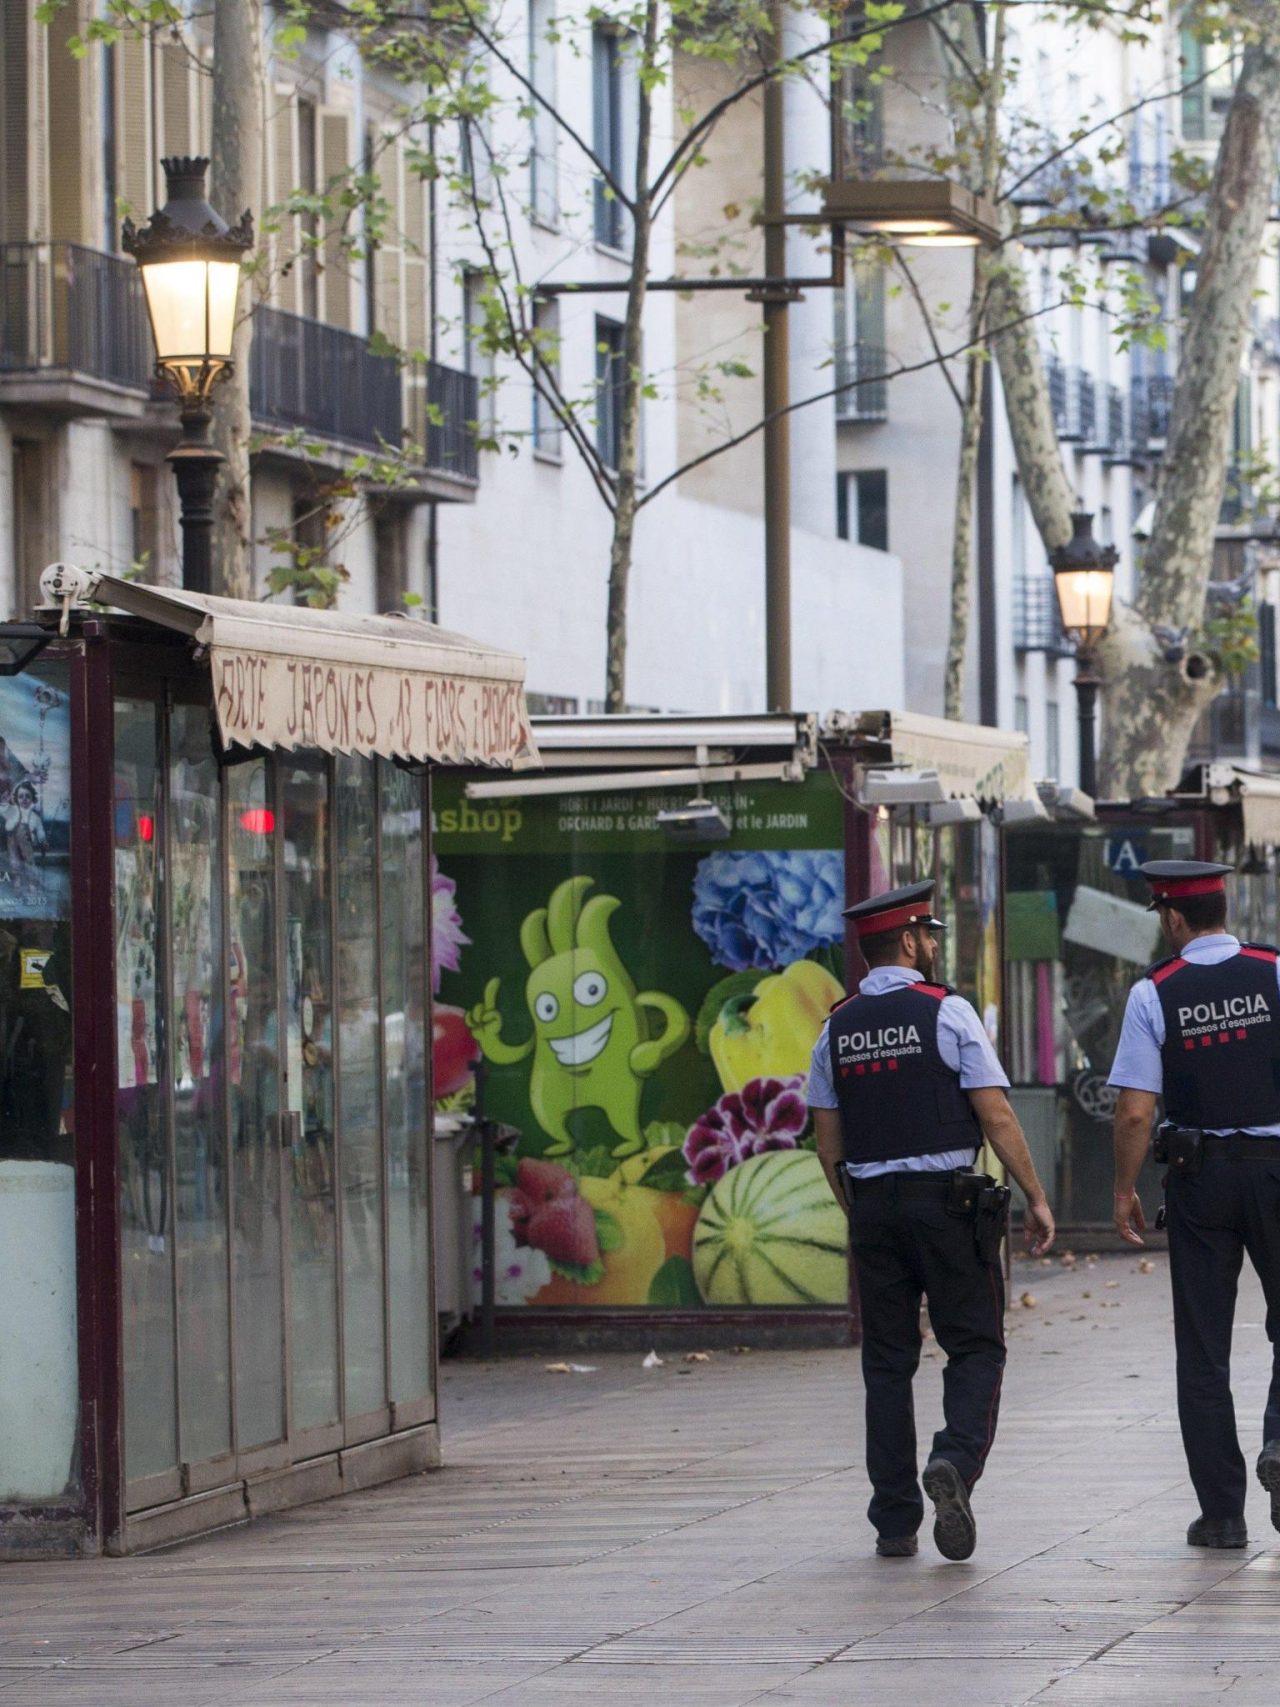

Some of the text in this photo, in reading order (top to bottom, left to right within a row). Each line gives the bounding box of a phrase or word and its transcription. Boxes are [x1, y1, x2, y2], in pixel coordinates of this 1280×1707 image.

[218, 656, 267, 730] ARTE
[287, 662, 377, 746] JAPONES
[765, 813, 808, 829] JARDIN
[1178, 993, 1270, 1027] POLICIA
[1182, 1013, 1272, 1037] mossos d'esquadra
[838, 1024, 921, 1055] POLICIA
[840, 1044, 922, 1065] mossos d'esquadra
